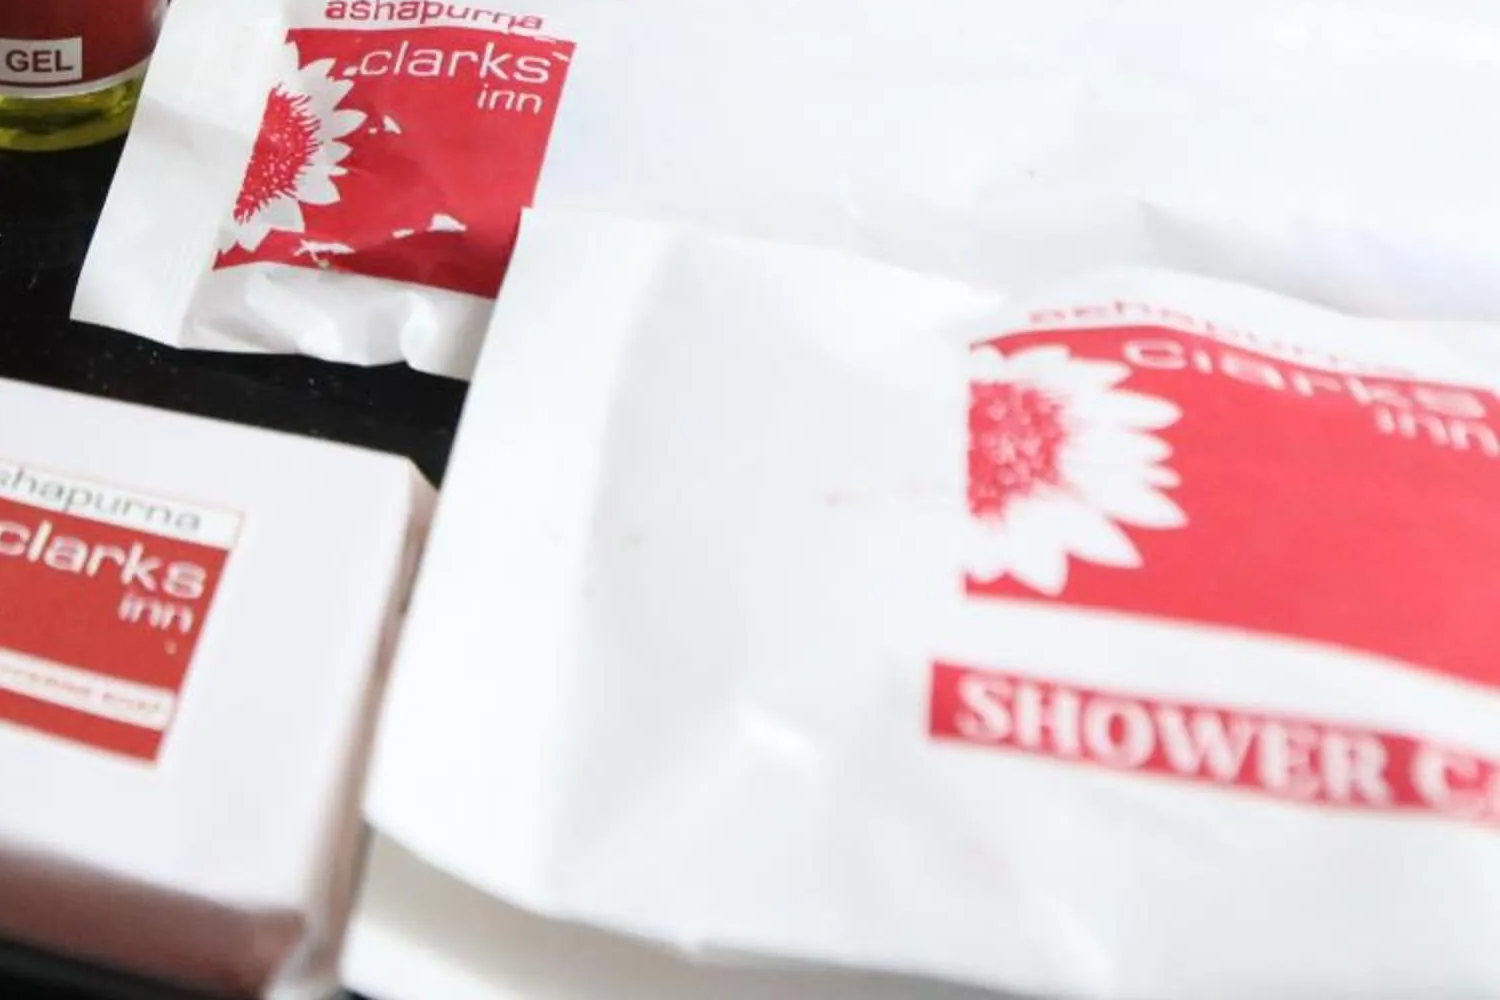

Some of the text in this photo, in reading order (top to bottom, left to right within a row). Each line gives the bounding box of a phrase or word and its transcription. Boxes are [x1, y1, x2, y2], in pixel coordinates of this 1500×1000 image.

[4, 48, 74, 74] GEL
[359, 41, 550, 85] clarks
[476, 83, 542, 115] inn
[1122, 338, 1488, 420] clarks
[117, 590, 195, 634] inn
[954, 672, 1500, 824] SHOWER C
